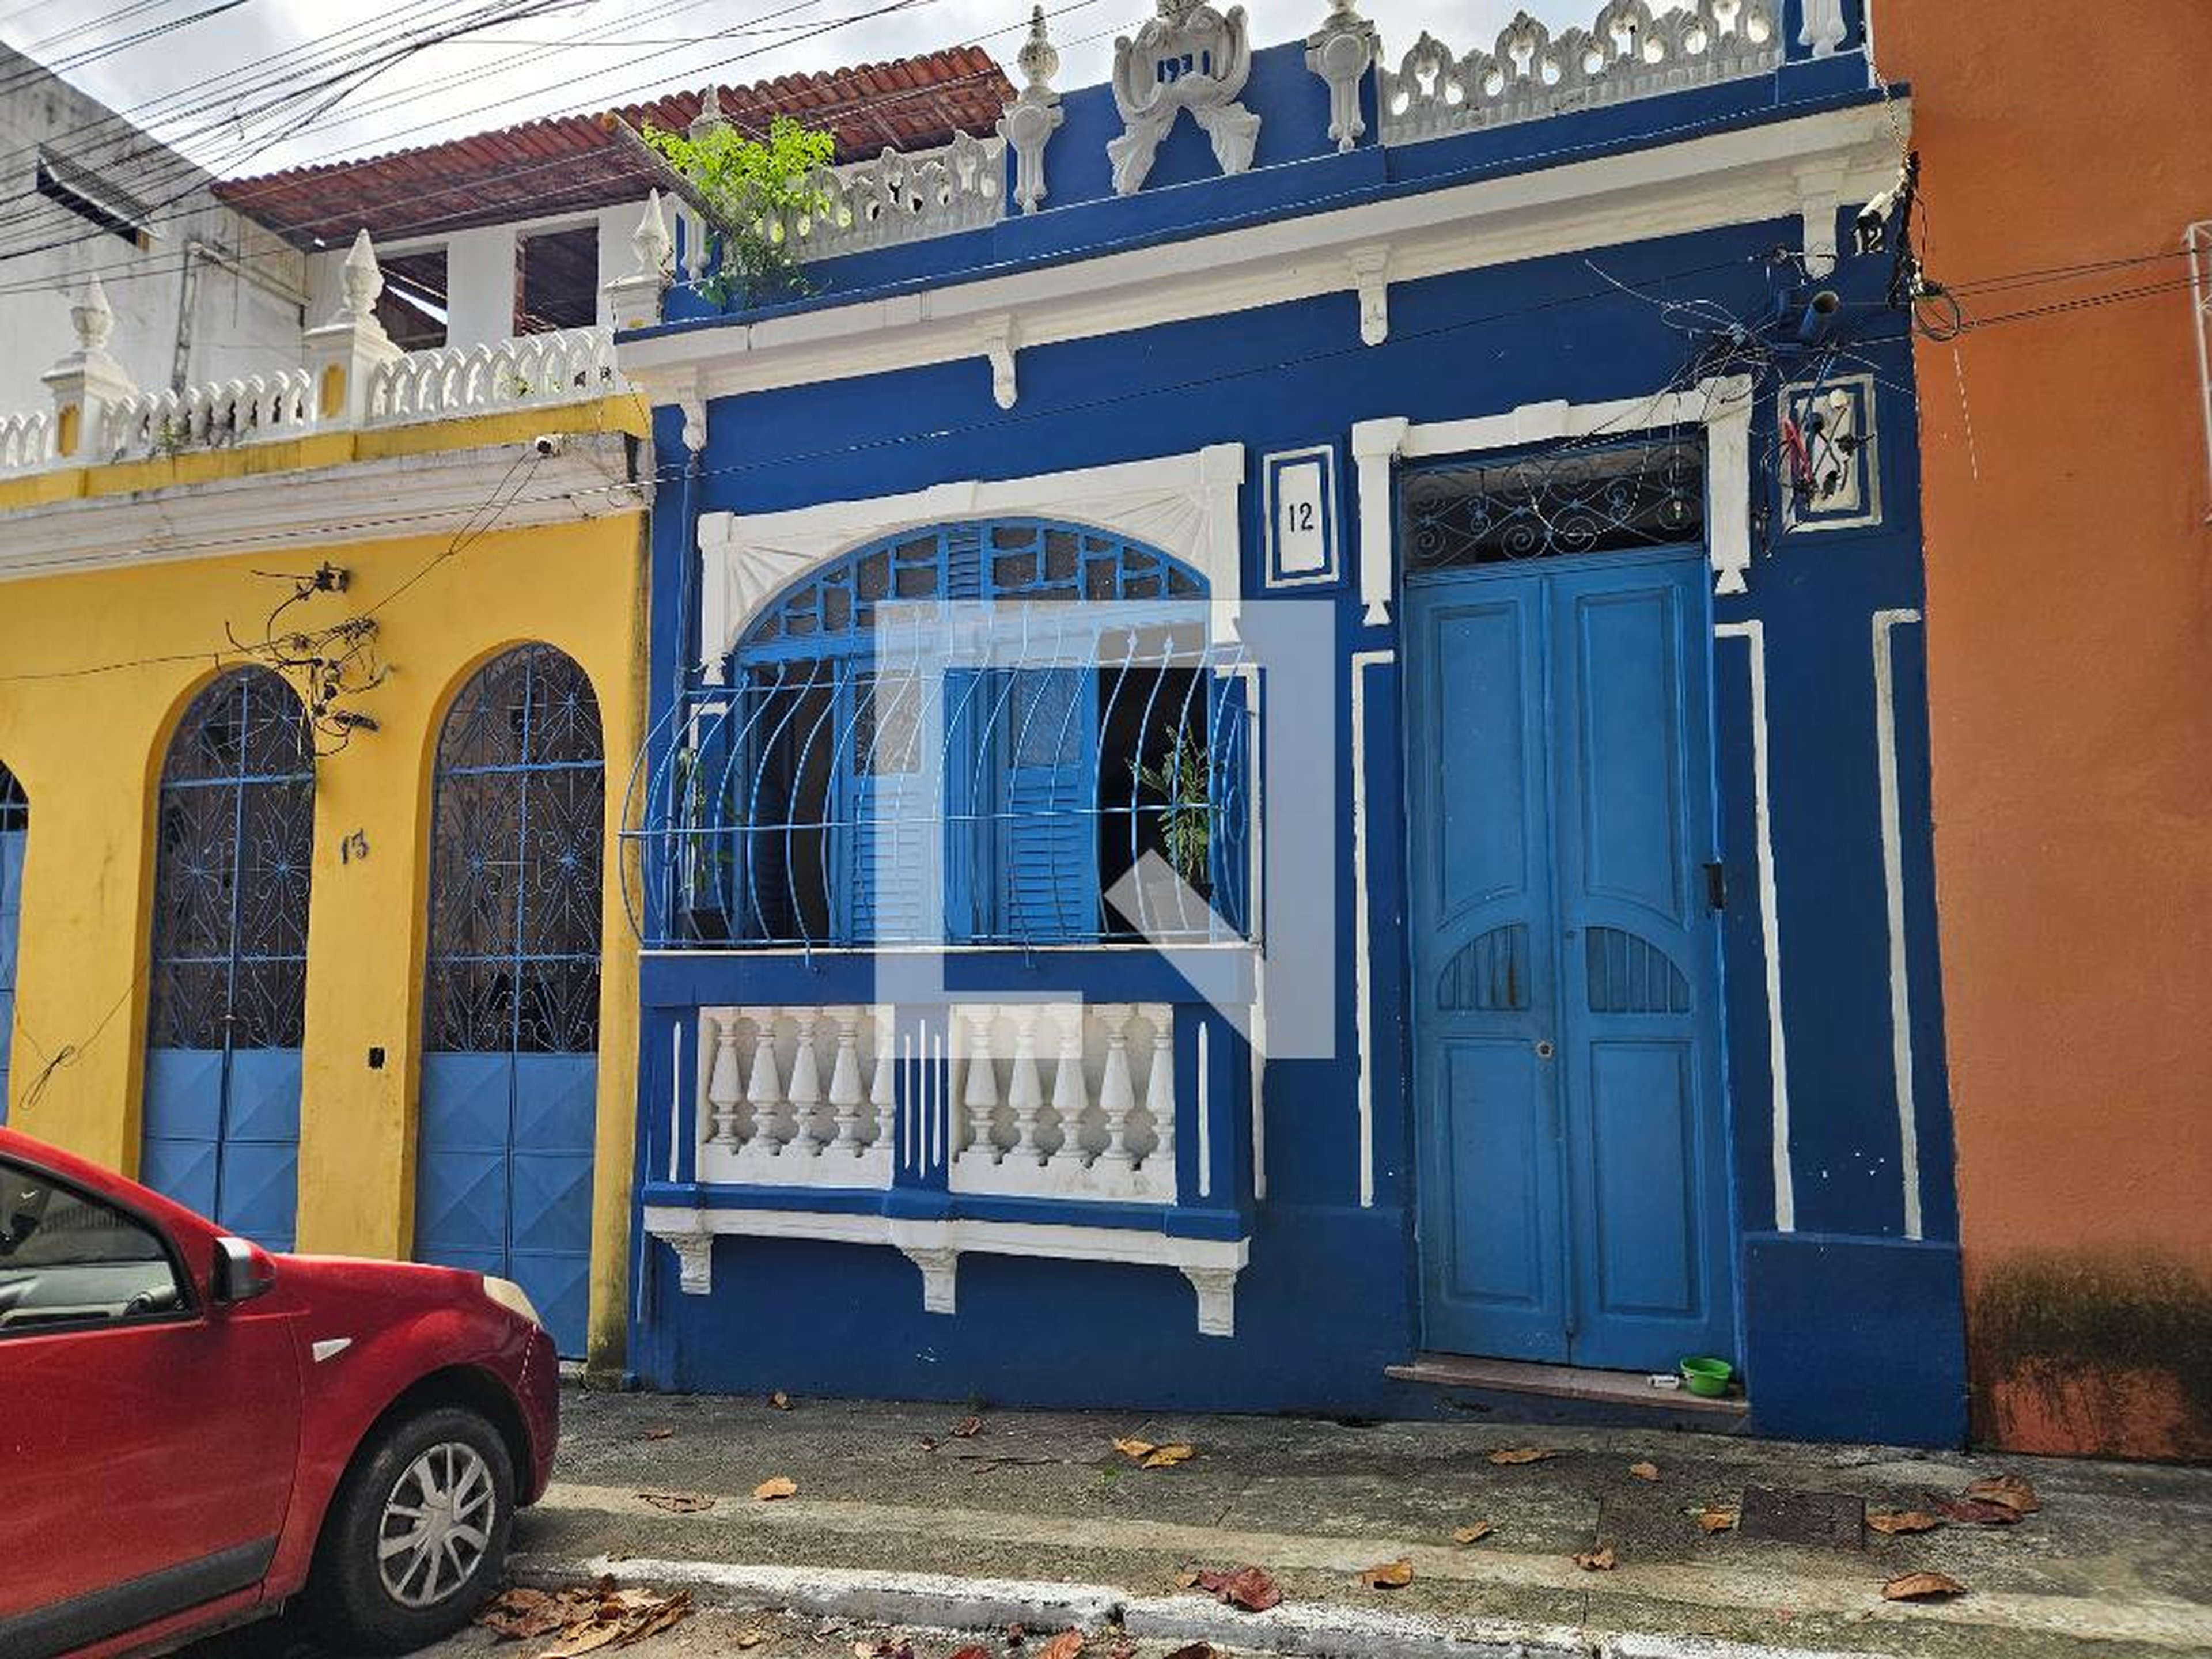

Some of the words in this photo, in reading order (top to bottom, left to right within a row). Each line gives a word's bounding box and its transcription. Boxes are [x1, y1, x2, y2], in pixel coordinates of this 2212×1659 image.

[1853, 226, 1884, 256] 12
[1289, 502, 1314, 532] 12
[341, 828, 369, 865] 13
